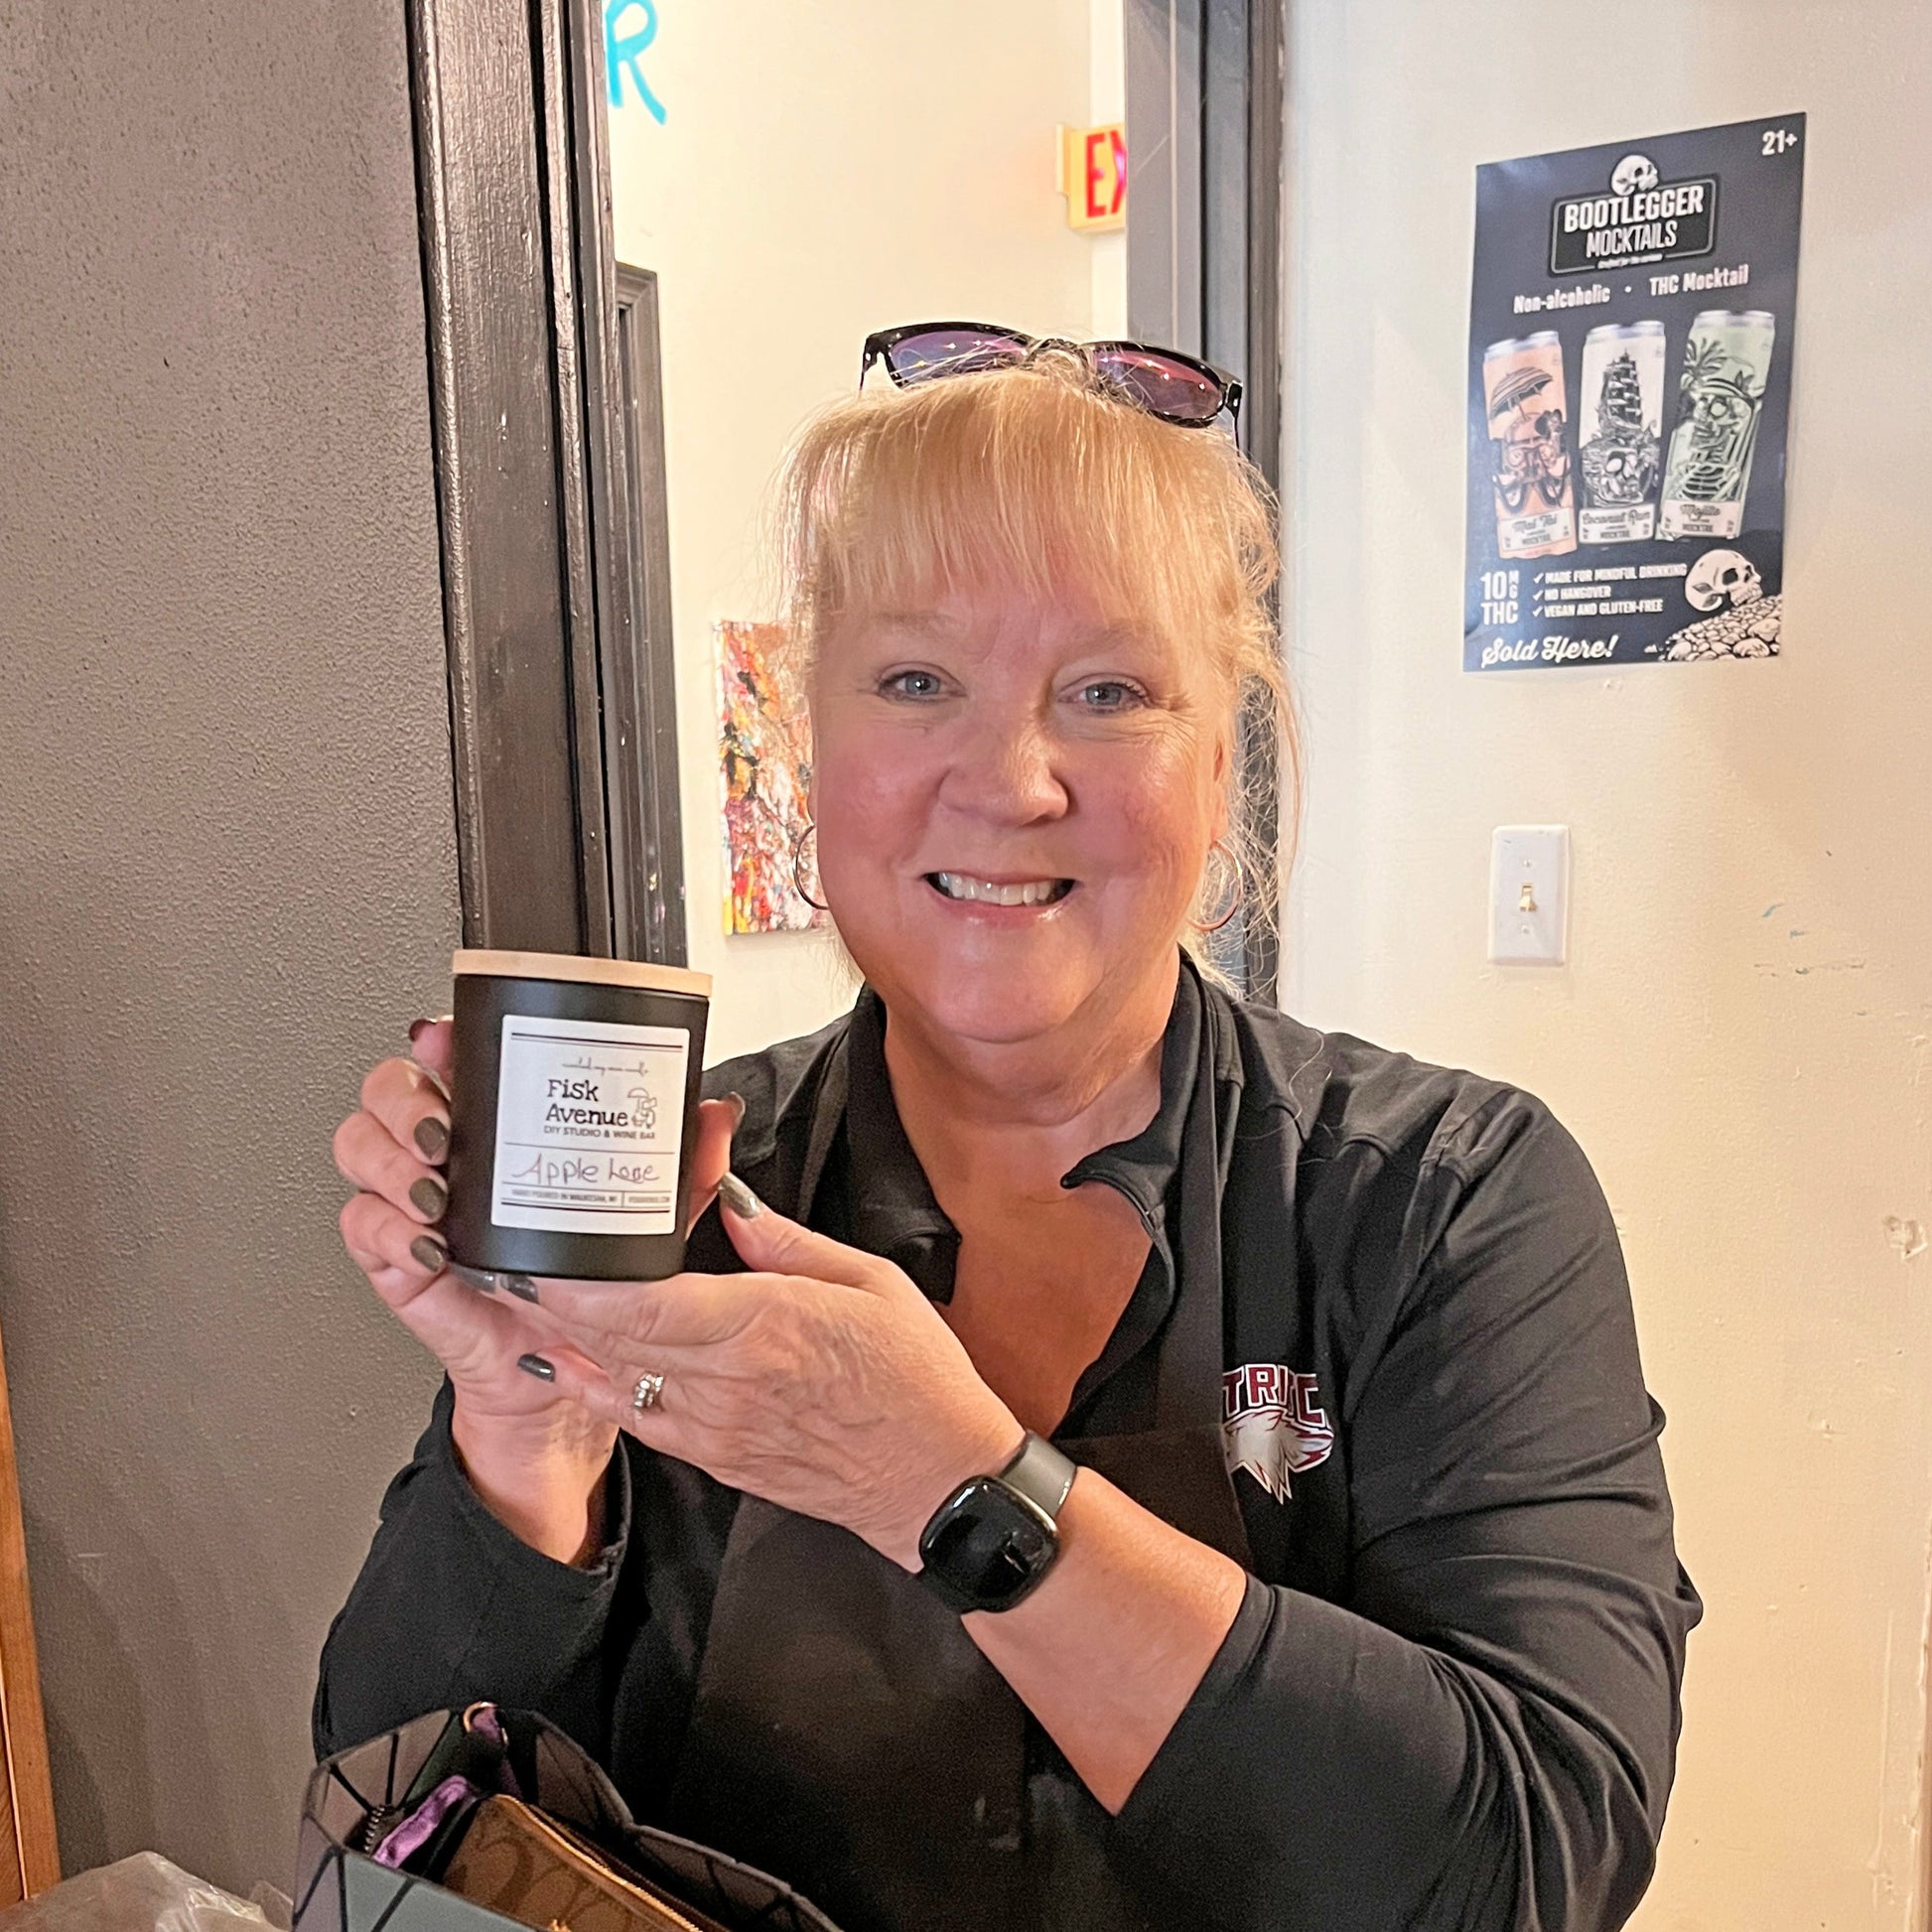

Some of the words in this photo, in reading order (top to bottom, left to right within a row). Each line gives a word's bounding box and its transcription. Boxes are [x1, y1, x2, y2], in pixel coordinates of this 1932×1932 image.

[605, 0, 667, 126] R
[1761, 130, 1797, 156] 21+
[1564, 185, 1705, 233] BOOTLEGGER
[1586, 219, 1678, 258] MOCKTAILS
[1513, 284, 1610, 314] Non-alcoholic
[1649, 274, 1680, 296] THC
[1683, 264, 1749, 292] Mocktail
[1480, 571, 1507, 601] 10
[1544, 571, 1573, 584] MADE
[1574, 569, 1592, 583] FOR
[1544, 588, 1559, 601] NO
[1480, 601, 1519, 625] THC
[1544, 604, 1576, 618] VEGAN
[1577, 602, 1597, 617] AND
[1598, 599, 1664, 616] GLUTEN-FREE
[1480, 637, 1539, 669] Sold
[1541, 633, 1619, 663] Here!
[547, 1078, 599, 1102] Fisk
[545, 1103, 628, 1127] Avenue
[543, 1125, 561, 1134] DIY
[563, 1127, 602, 1138] STUDIO
[511, 1154, 599, 1186] Apple
